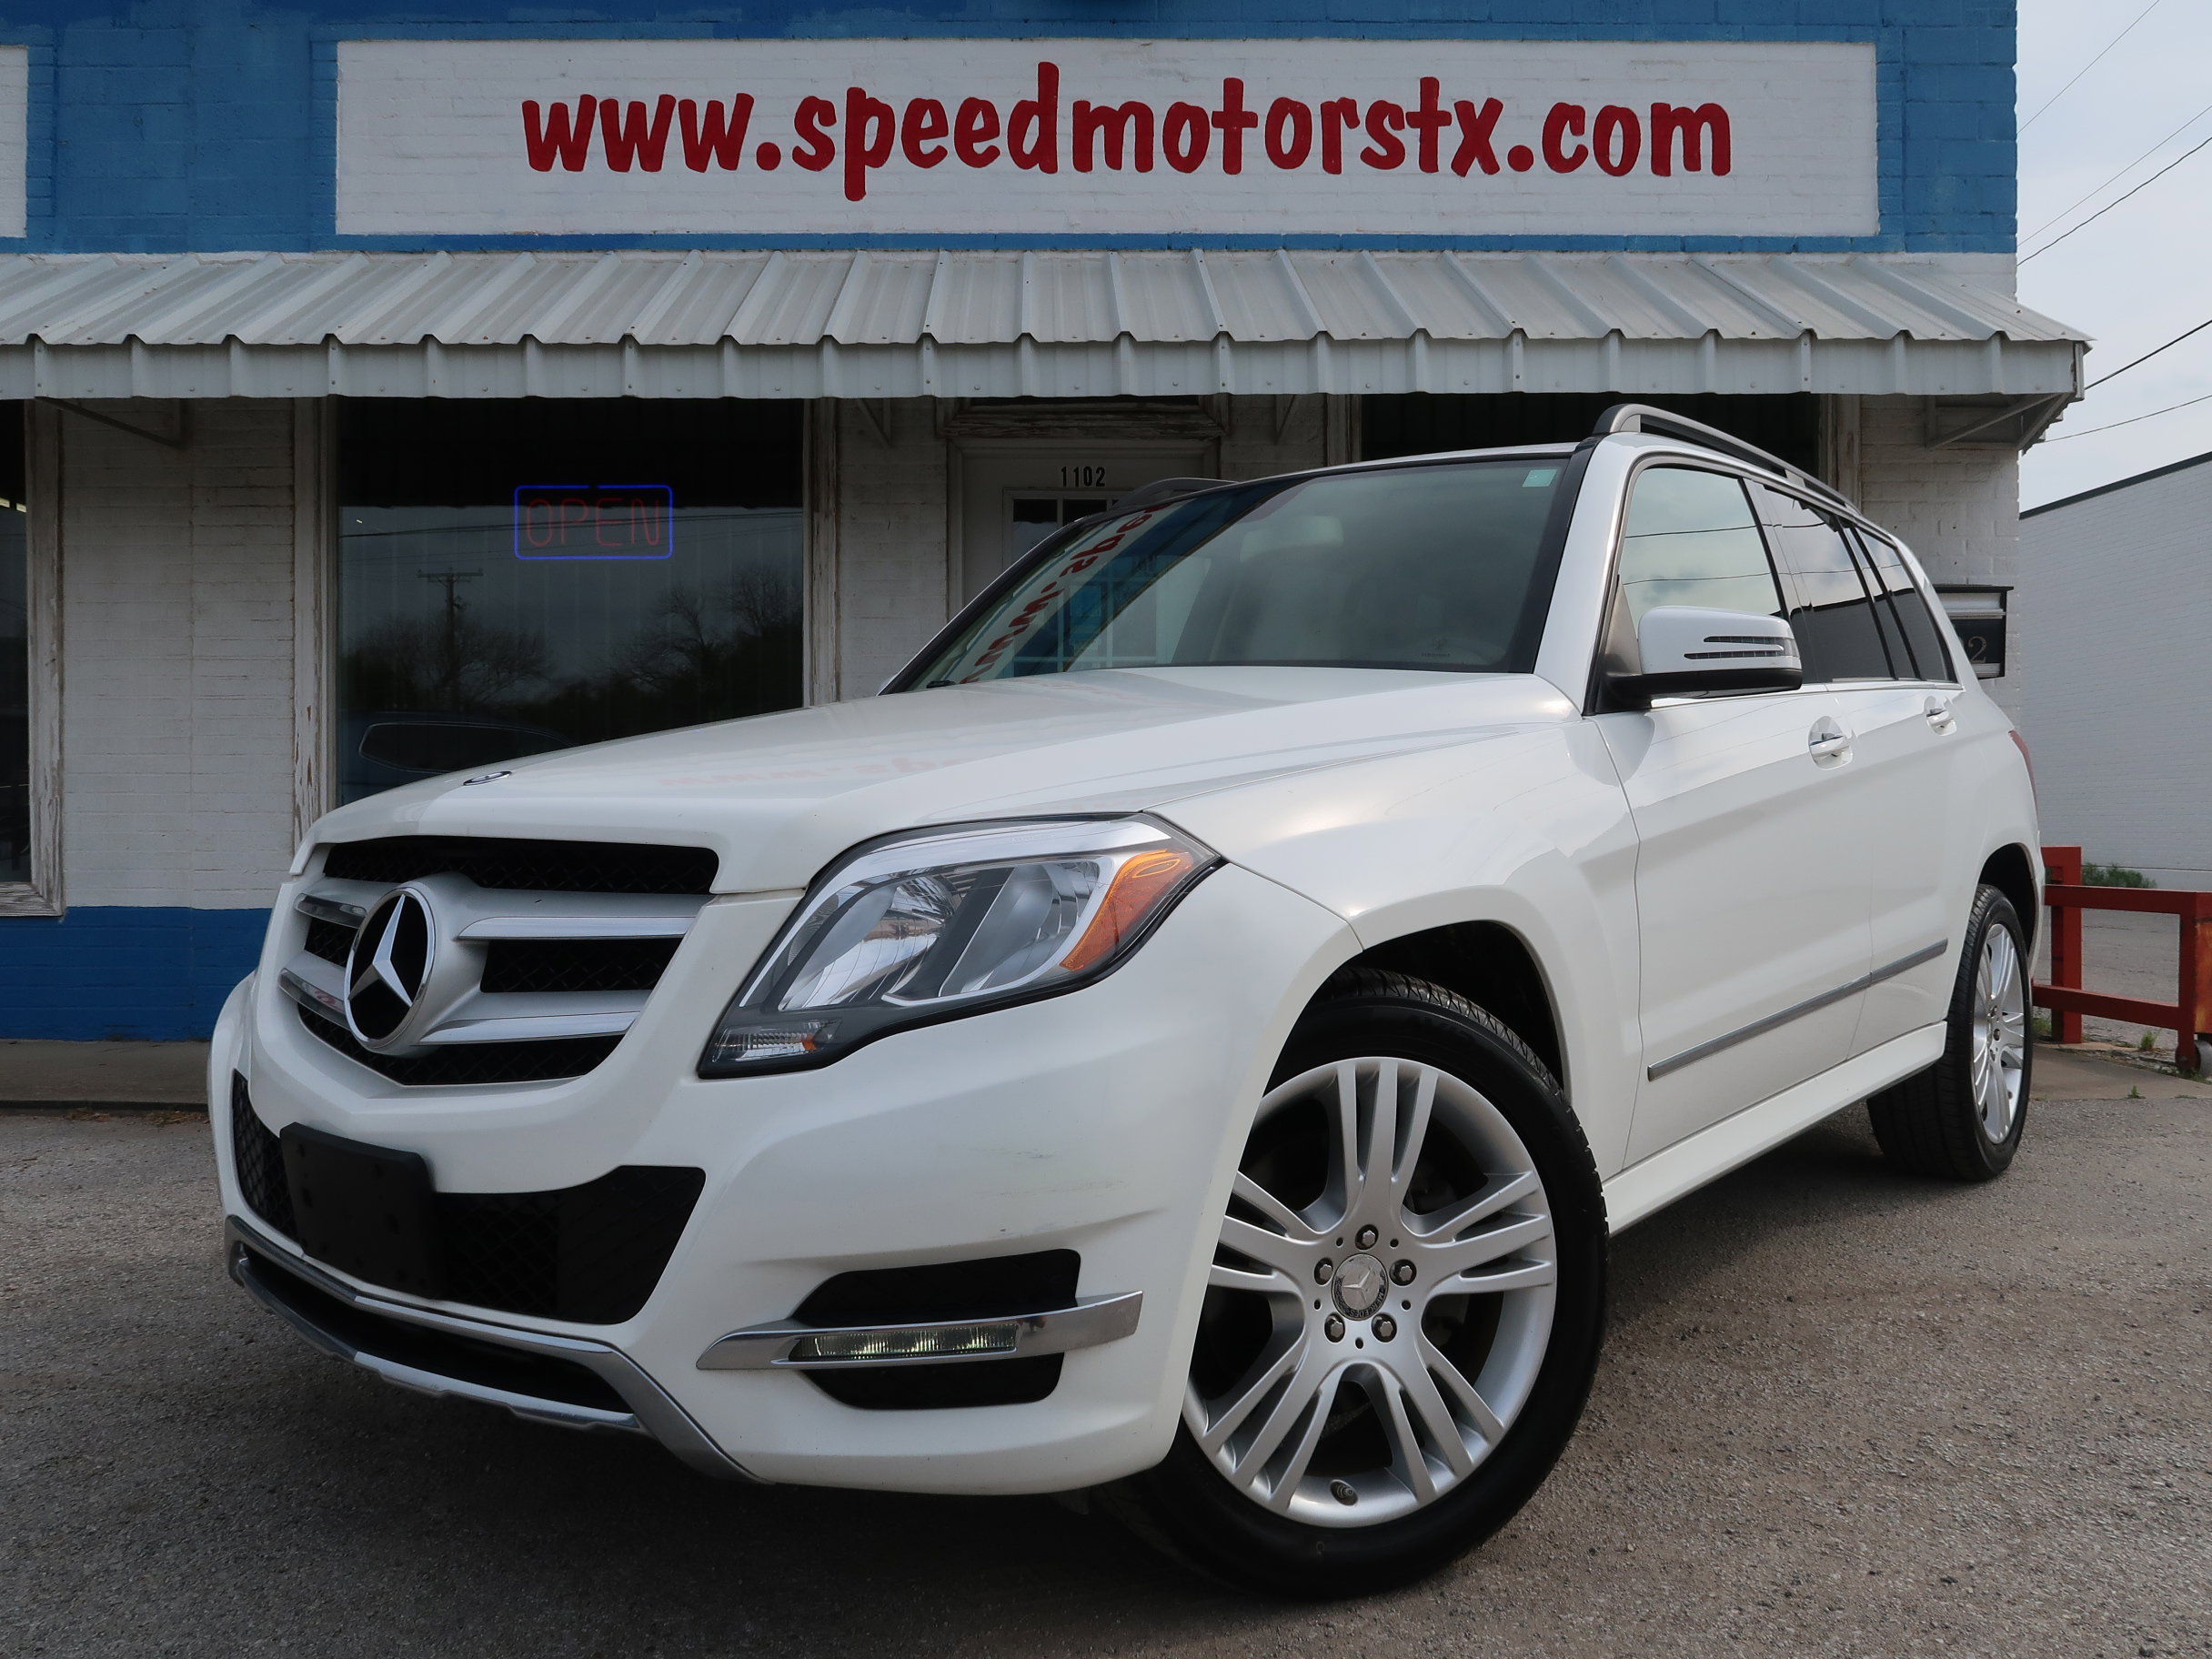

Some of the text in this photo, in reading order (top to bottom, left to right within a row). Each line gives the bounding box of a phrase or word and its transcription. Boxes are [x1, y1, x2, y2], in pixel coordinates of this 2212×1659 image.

[523, 62, 1730, 200] www.speedmotorstx.com
[1061, 466, 1106, 488] 1102
[526, 498, 661, 547] OPEN
